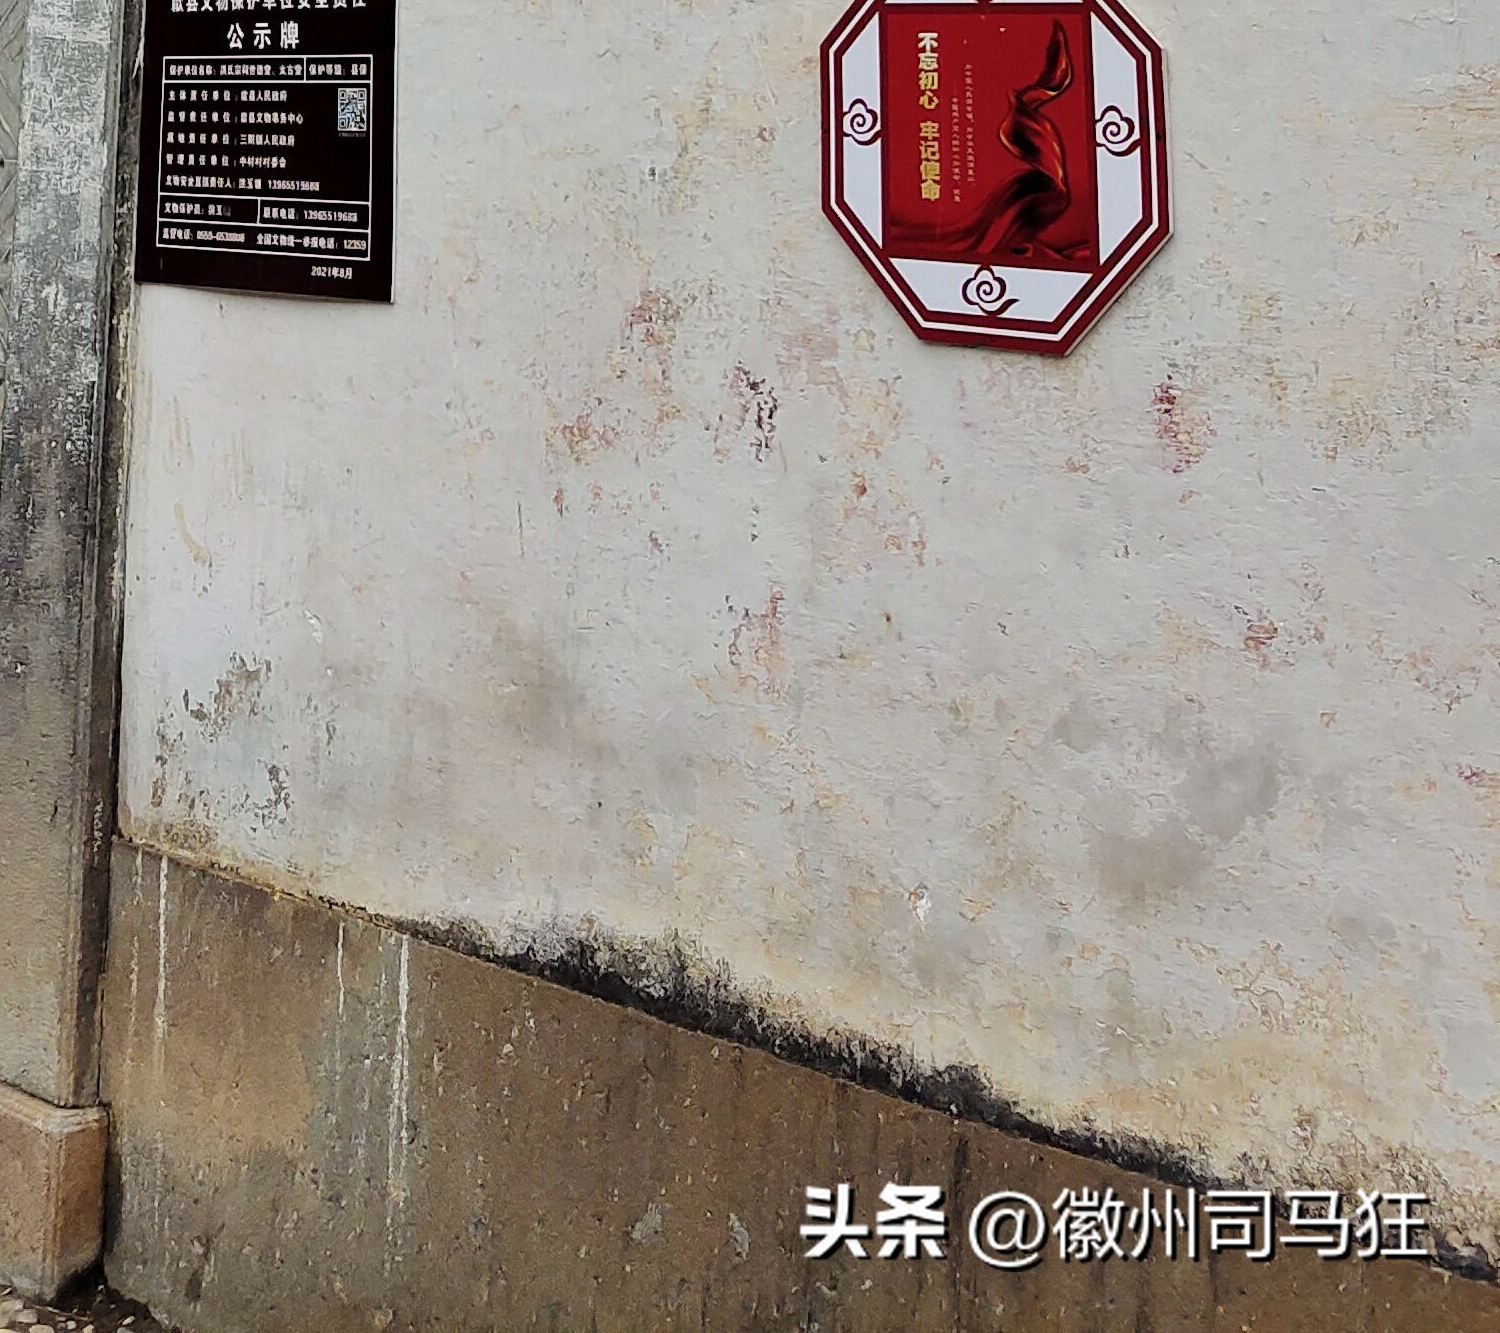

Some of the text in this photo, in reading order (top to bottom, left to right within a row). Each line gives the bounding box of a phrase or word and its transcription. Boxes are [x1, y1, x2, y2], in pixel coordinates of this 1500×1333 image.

[226, 20, 300, 50] 公示牌
[917, 32, 941, 201] 不忘初心 牢记使命
